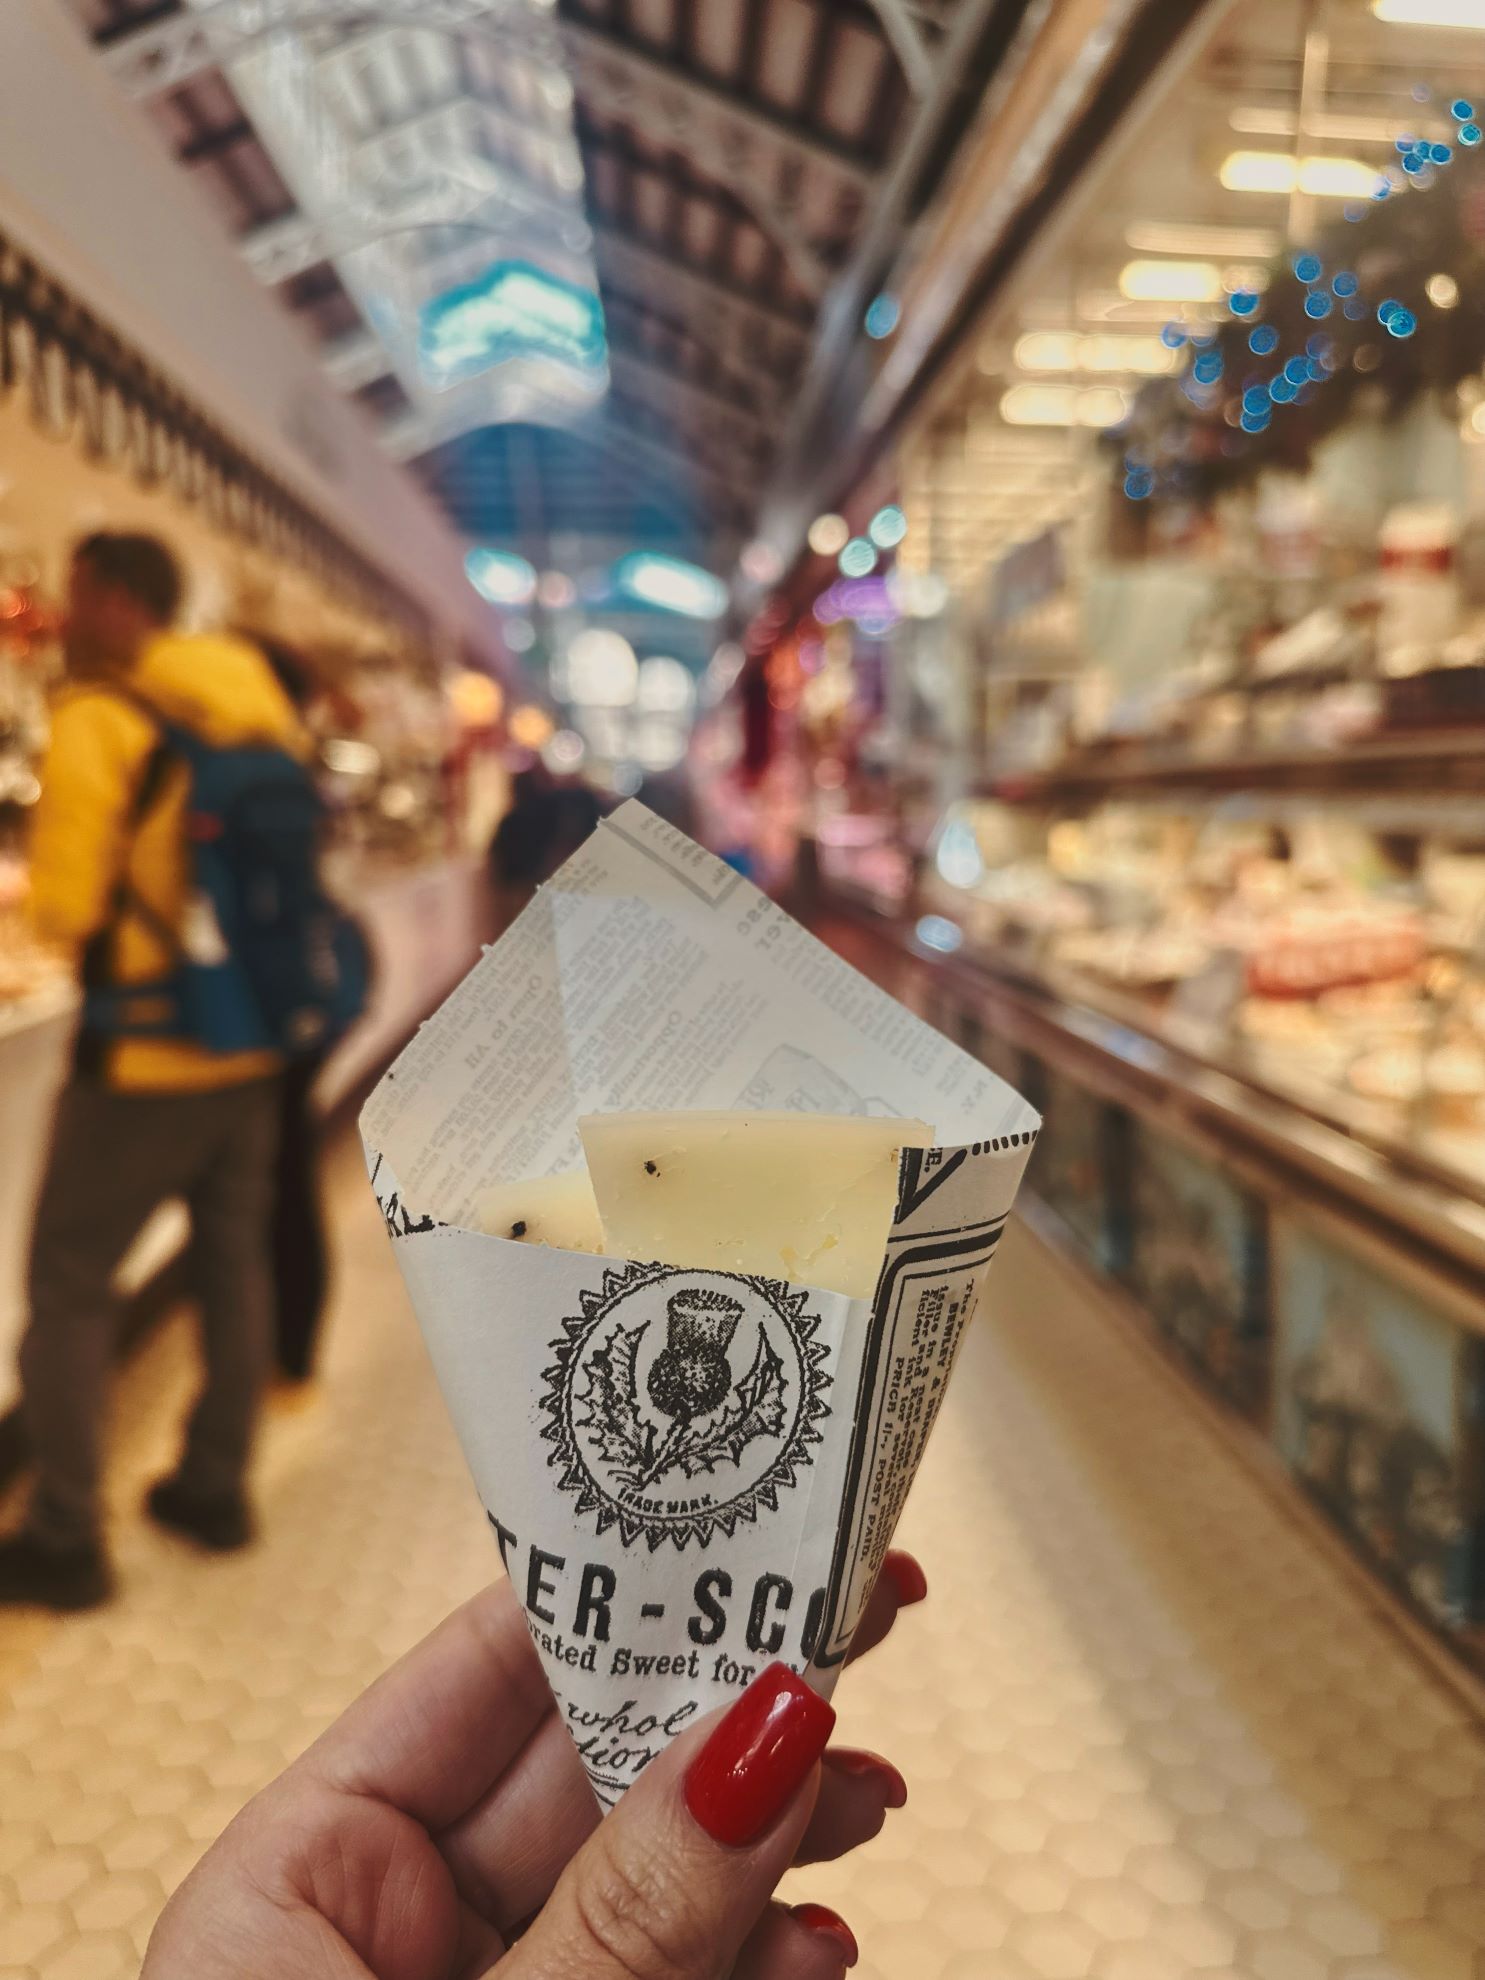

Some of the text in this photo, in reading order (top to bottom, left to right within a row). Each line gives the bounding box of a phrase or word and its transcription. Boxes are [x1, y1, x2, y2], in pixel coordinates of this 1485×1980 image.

[921, 1288, 939, 1338] Filler
[930, 1286, 949, 1333] issue
[959, 1278, 975, 1314] The
[911, 1289, 930, 1347] ficient
[936, 1302, 959, 1367] BEWLEY
[913, 1343, 928, 1379] and
[924, 1338, 936, 1359] in
[886, 1357, 905, 1414] PRICE
[903, 1356, 916, 1389] ink
[897, 1395, 908, 1422] for
[911, 1385, 927, 1424] neat
[882, 1433, 901, 1497] several
[901, 1429, 918, 1469] case
[617, 1488, 663, 1514] TRADE
[870, 1459, 886, 1506] POST
[859, 1515, 876, 1563] PAID.
[609, 1647, 700, 1679] Sweet
[711, 1653, 756, 1688] for
